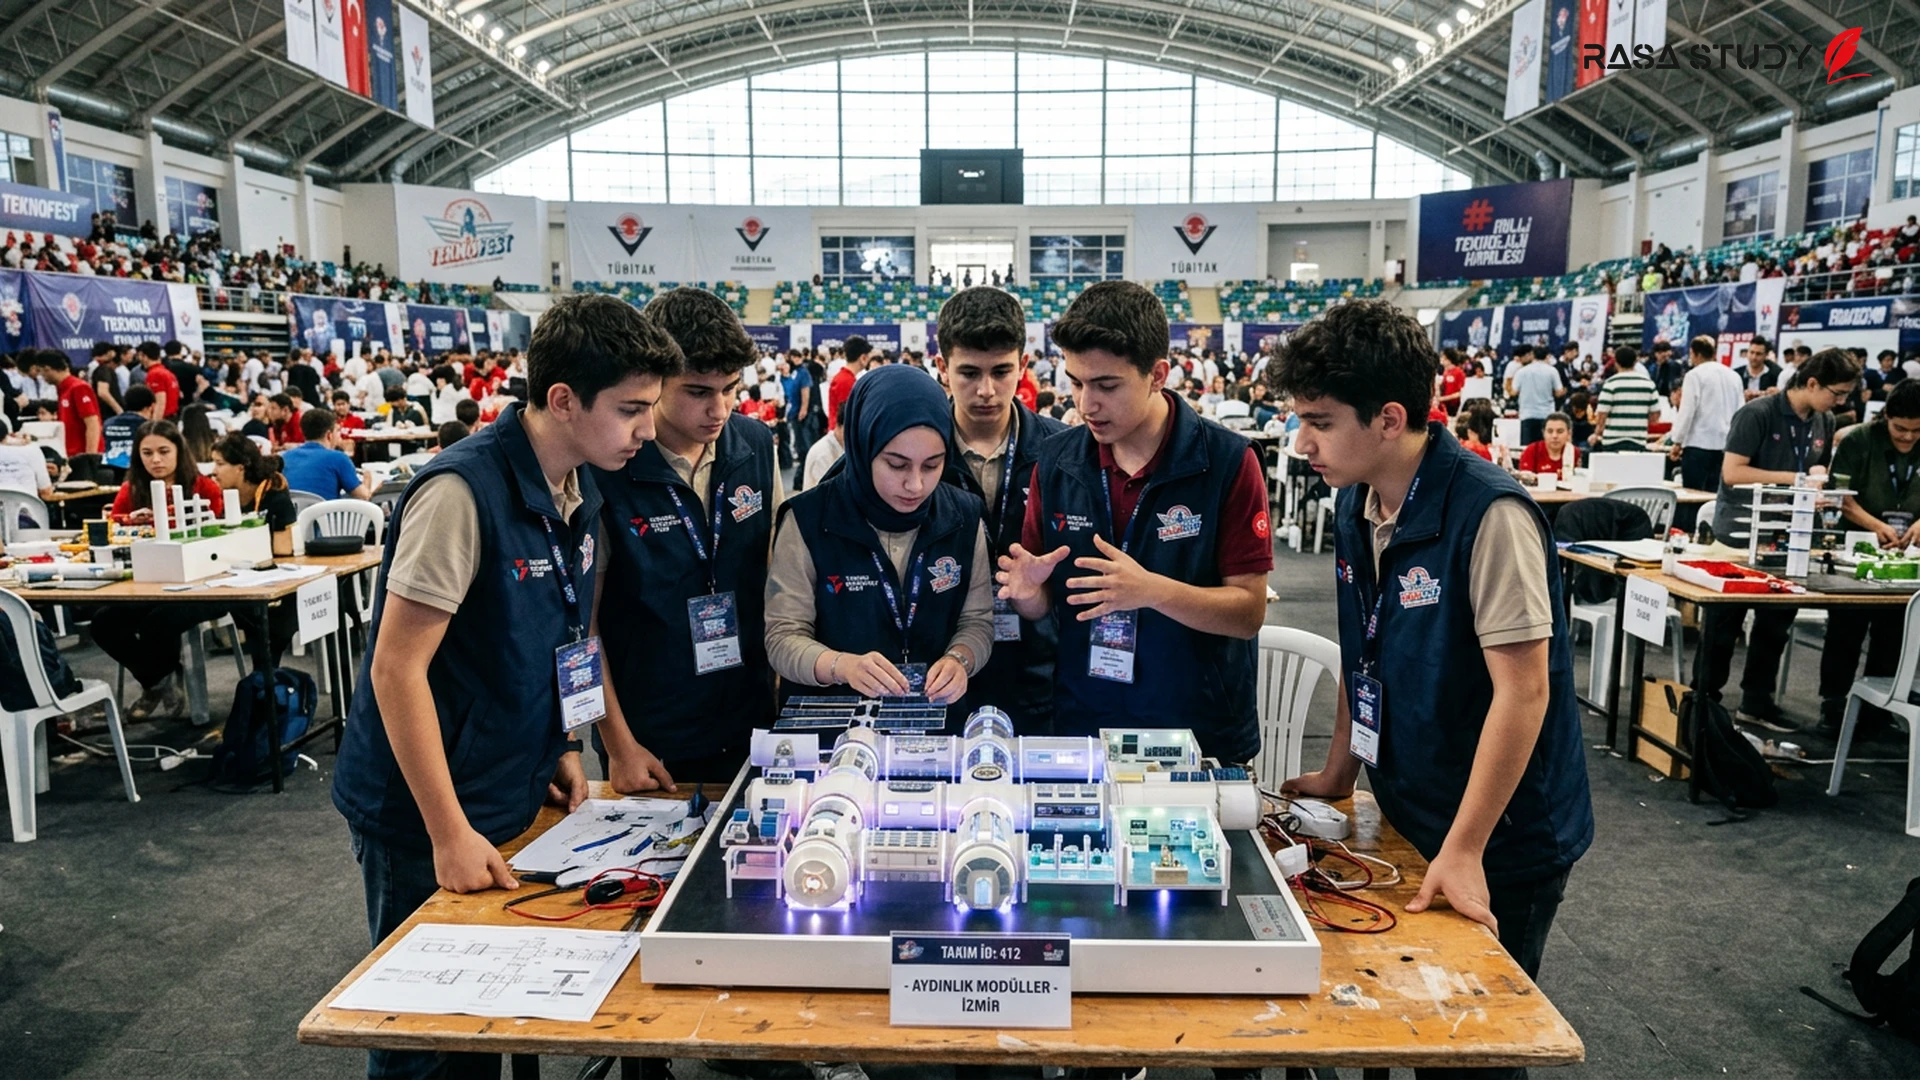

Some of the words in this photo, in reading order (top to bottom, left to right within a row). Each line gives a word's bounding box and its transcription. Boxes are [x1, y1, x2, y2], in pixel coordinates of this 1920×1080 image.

[1, 194, 80, 222] TEKNOFEST
[608, 261, 656, 275] TÜBİTAK
[941, 945, 978, 959] TAKIM
[1000, 947, 1021, 960] 412
[912, 979, 974, 993] AYDINLIK
[976, 977, 1051, 994] MODÜLLER
